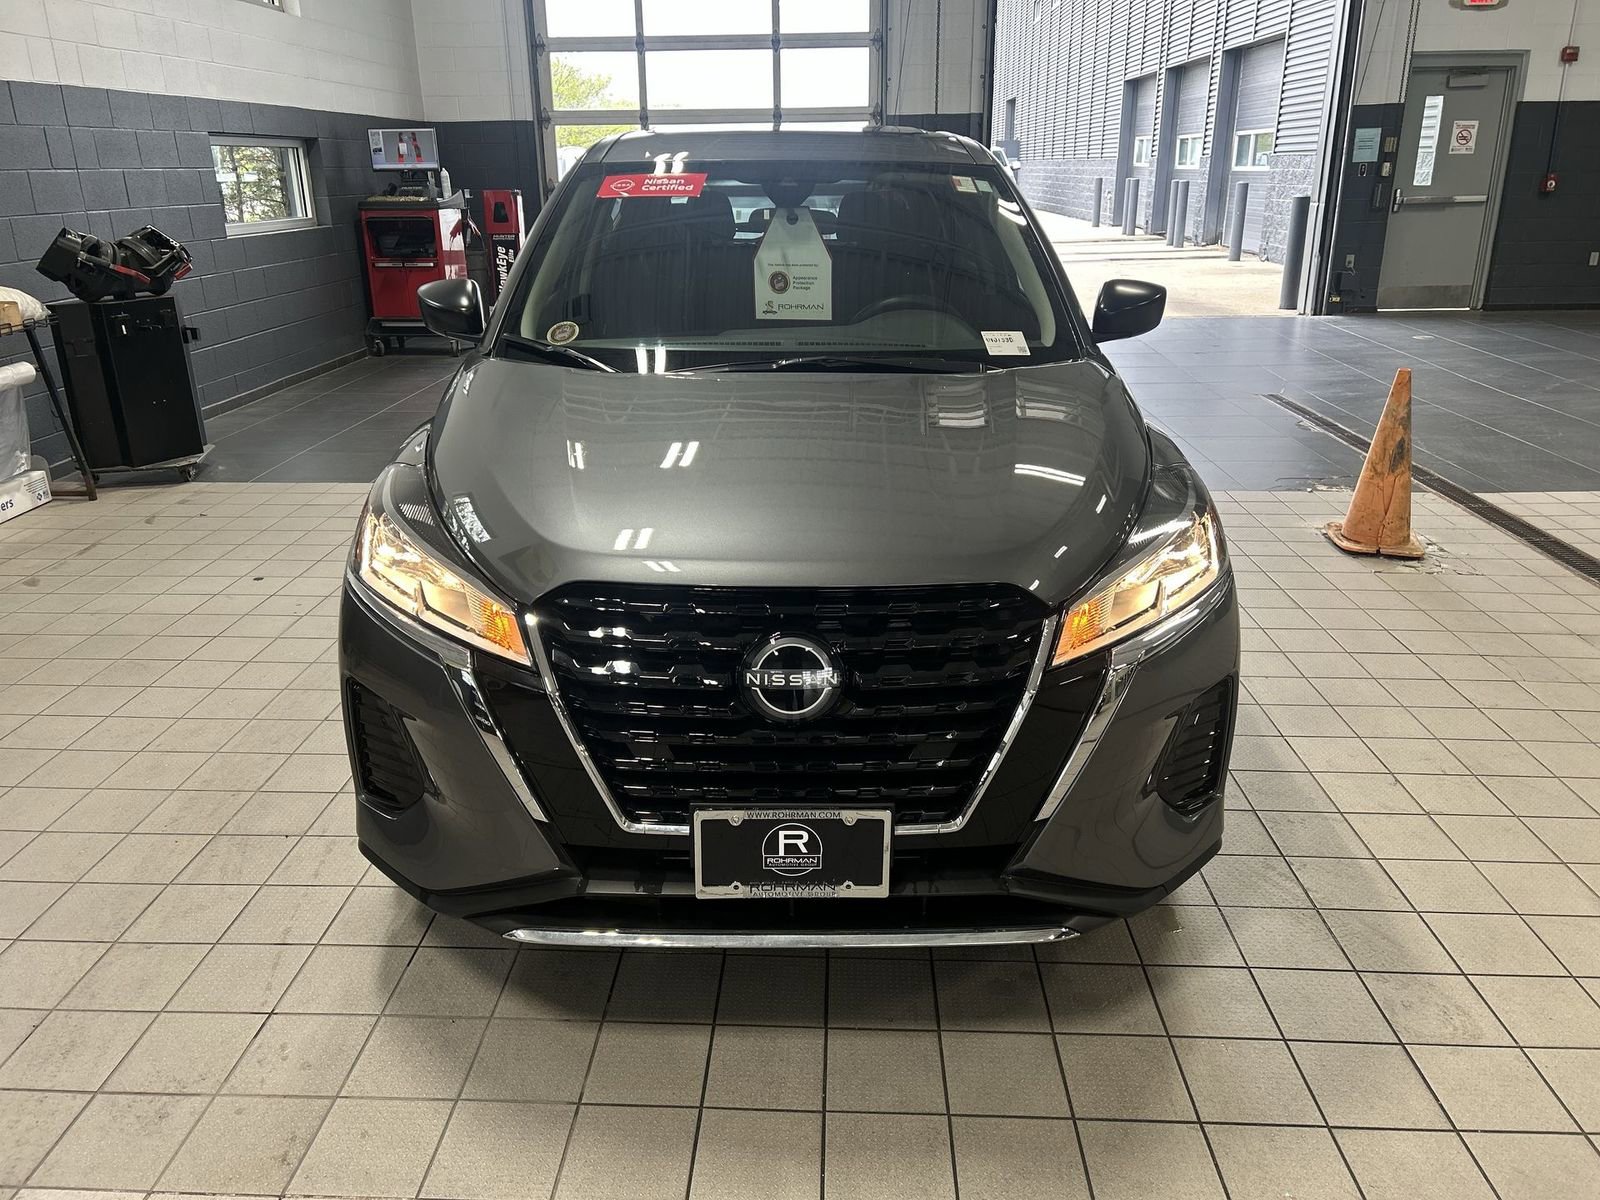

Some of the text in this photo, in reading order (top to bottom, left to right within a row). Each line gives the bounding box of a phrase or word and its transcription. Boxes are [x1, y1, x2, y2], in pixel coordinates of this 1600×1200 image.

[0, 499, 14, 511] ers
[746, 672, 838, 686] NISSAN
[747, 811, 841, 819] WWW.ROHRMAN.COM
[778, 830, 809, 856] R
[749, 882, 836, 893] ROHRMAN
